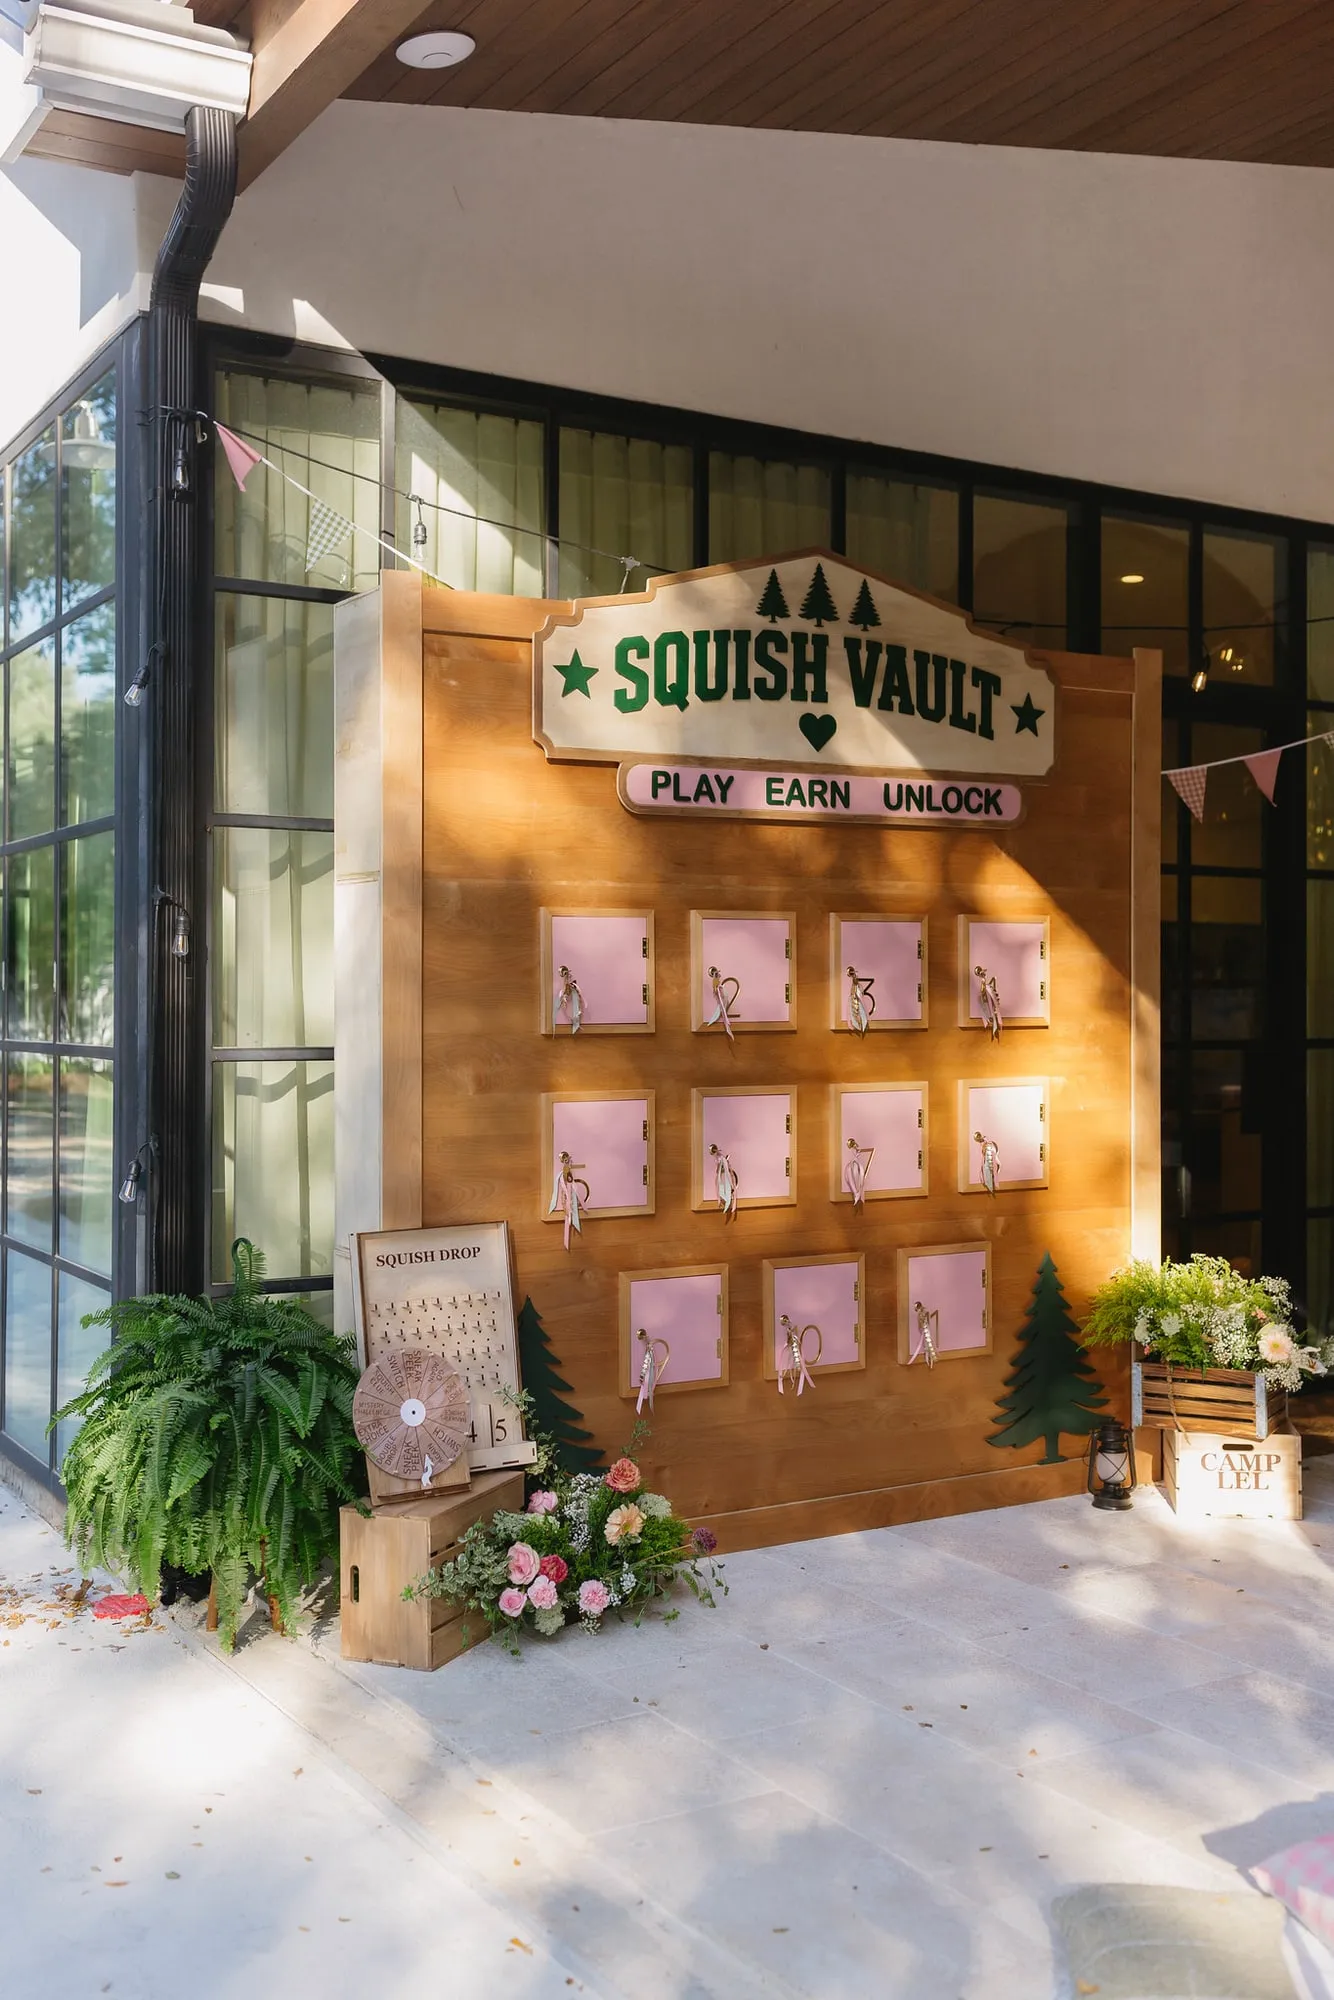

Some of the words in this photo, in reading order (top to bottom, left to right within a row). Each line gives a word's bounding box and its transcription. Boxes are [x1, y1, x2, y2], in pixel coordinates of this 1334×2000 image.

[613, 629, 829, 715] SQUISH
[843, 636, 1002, 741] VAULT
[650, 770, 735, 805] PLAY
[765, 777, 851, 809] EARN
[883, 783, 1003, 816] UNLOCK
[718, 977, 740, 1018] 2
[856, 977, 876, 1016] 3
[857, 1147, 876, 1181] 7
[376, 1250, 436, 1269] SQUISH
[438, 1246, 481, 1262] DROP
[387, 1354, 406, 1389] SWITCH
[432, 1425, 462, 1454] SWITCH
[495, 1418, 508, 1442] 5
[403, 1440, 412, 1475] SNEAK
[411, 1445, 420, 1472] PEEK
[1200, 1452, 1282, 1472] CAMP
[1217, 1471, 1270, 1490] LEL
